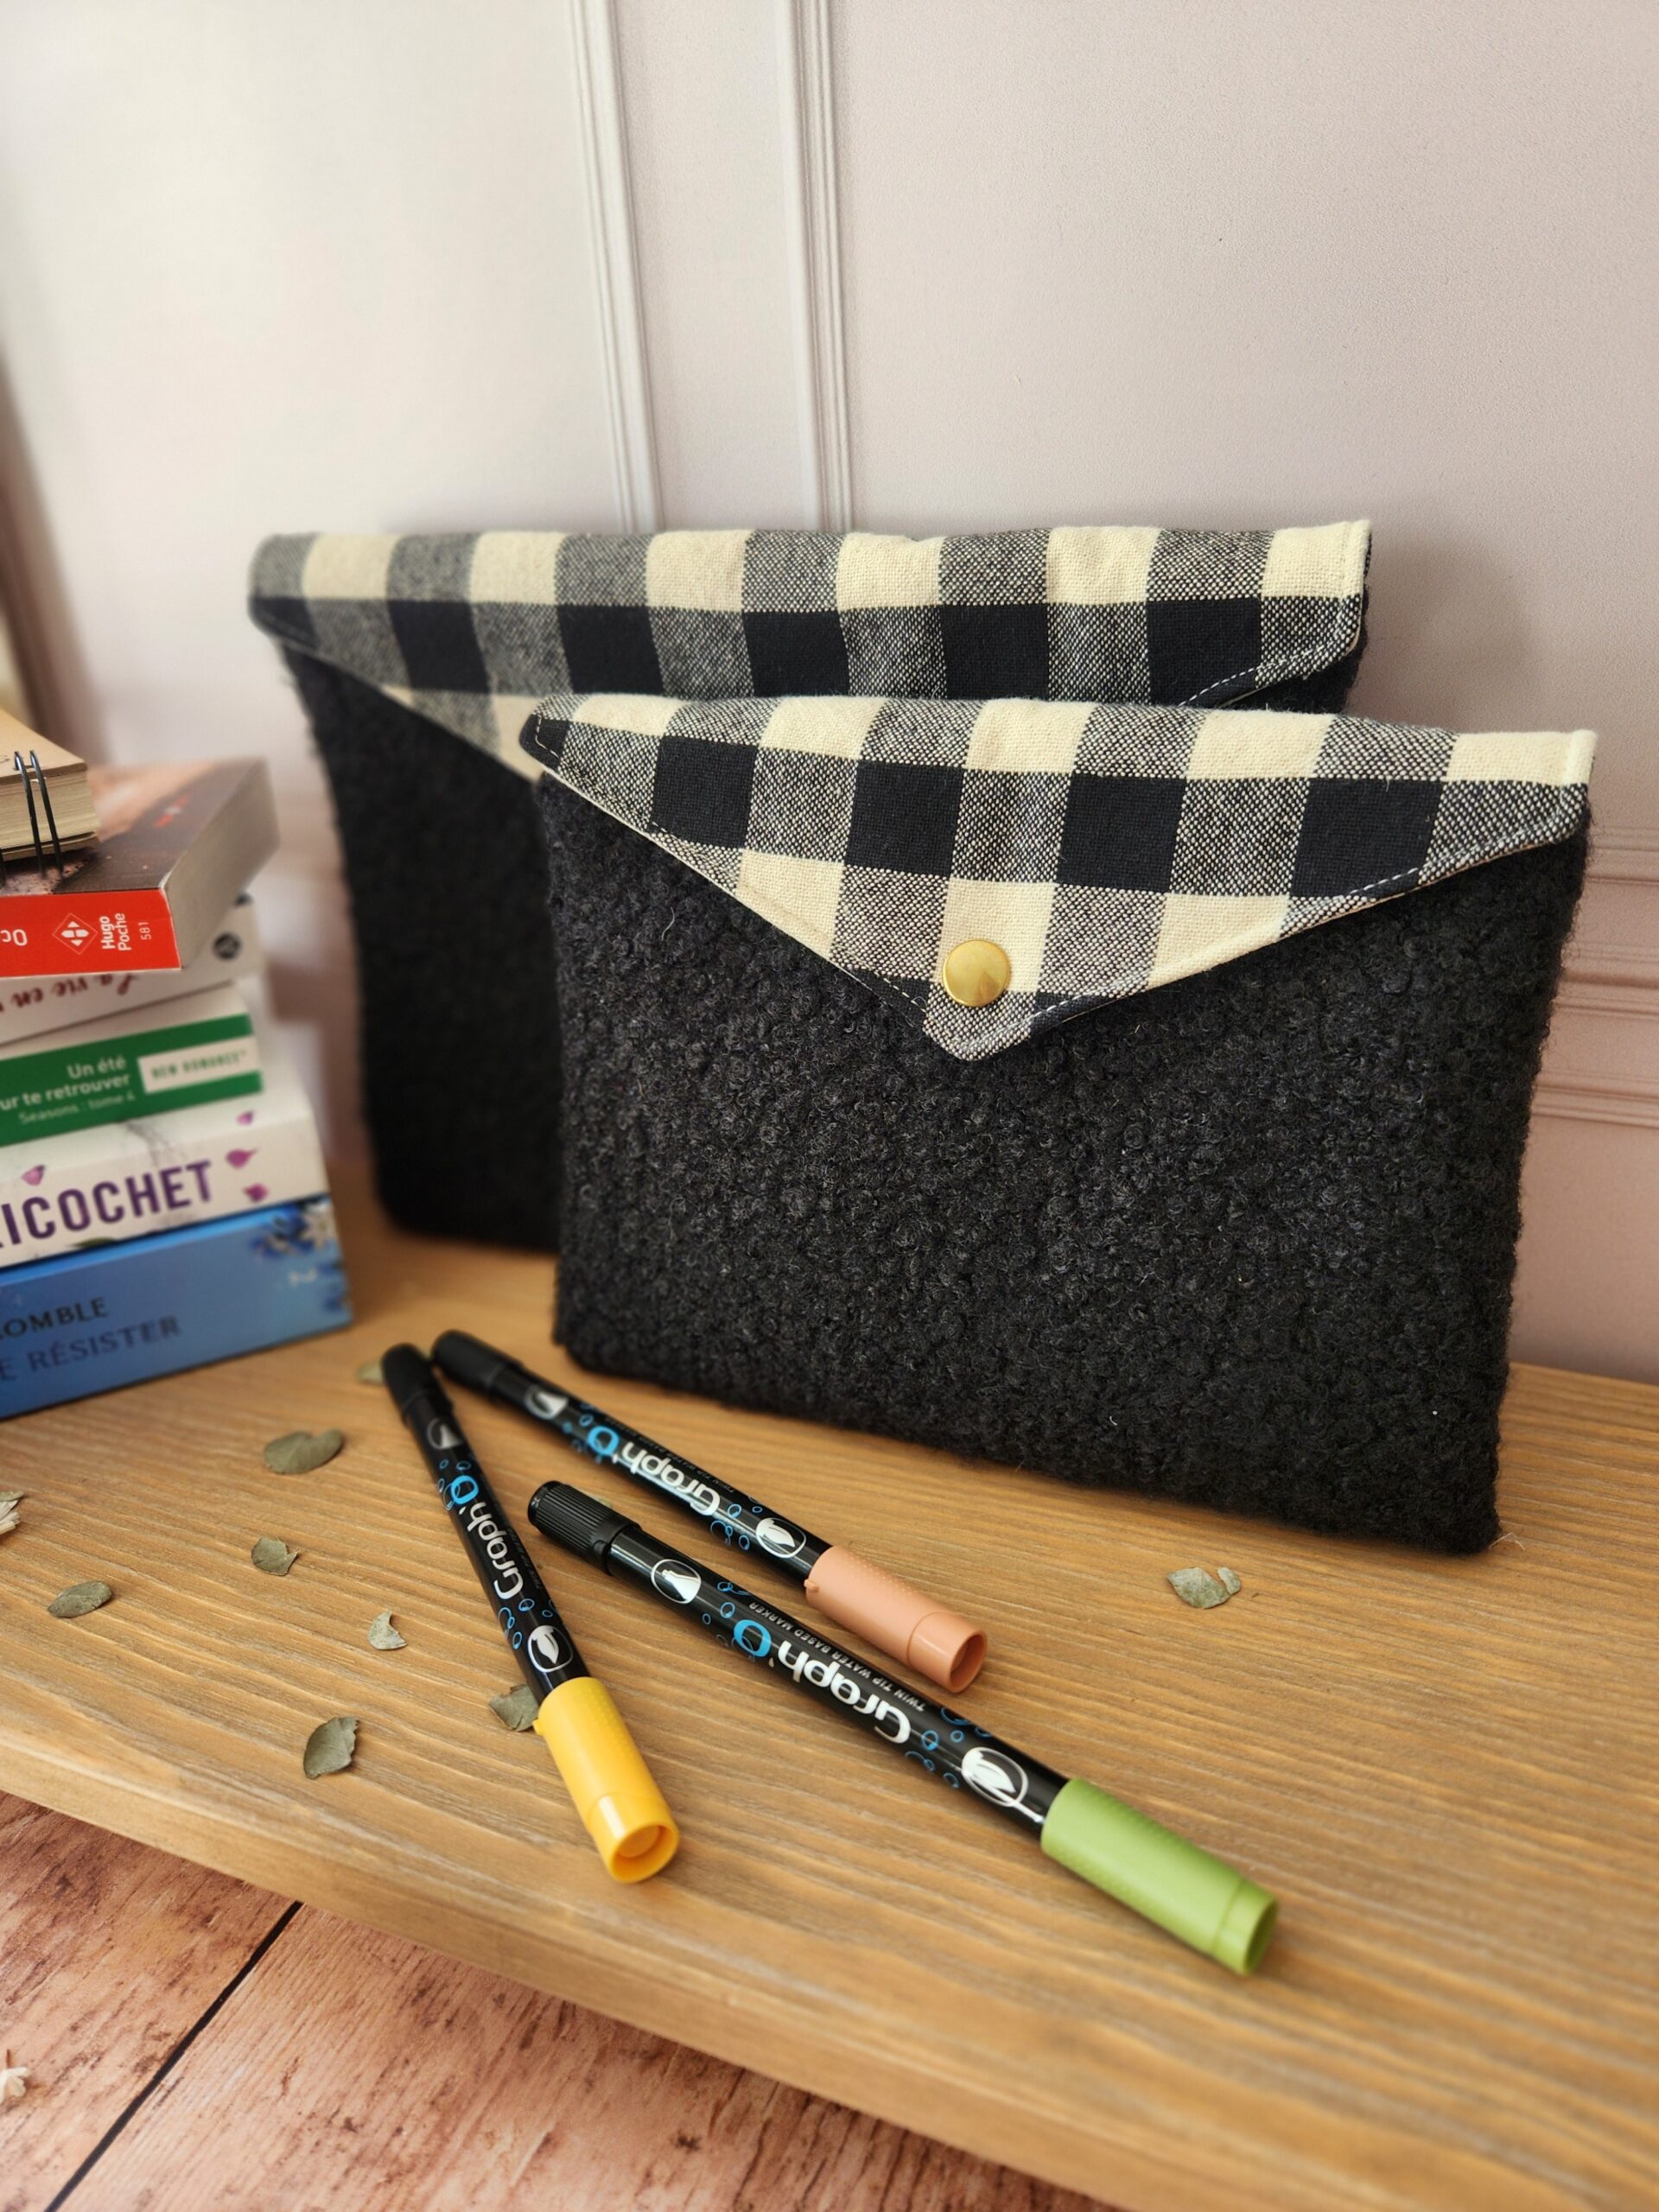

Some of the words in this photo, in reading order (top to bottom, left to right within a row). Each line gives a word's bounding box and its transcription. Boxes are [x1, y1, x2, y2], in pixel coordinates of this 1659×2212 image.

[99, 916, 116, 950] Hugo
[115, 912, 132, 950] Poche
[138, 921, 152, 940] 581
[67, 1064, 94, 1080] Un
[97, 1054, 127, 1073] été
[22, 1092, 42, 1107] te
[45, 1073, 130, 1103] retrouver
[19, 1104, 79, 1124] Seasons
[0, 1160, 212, 1249] ICOCHET
[0, 1297, 109, 1340] OMBLE
[28, 1315, 182, 1372] RÉSISTER
[748, 1601, 792, 1631] MARKER
[793, 1628, 830, 1653] BASED
[831, 1650, 871, 1680] WATER
[872, 1677, 897, 1693] TIP
[893, 1689, 927, 1713] TWIN
